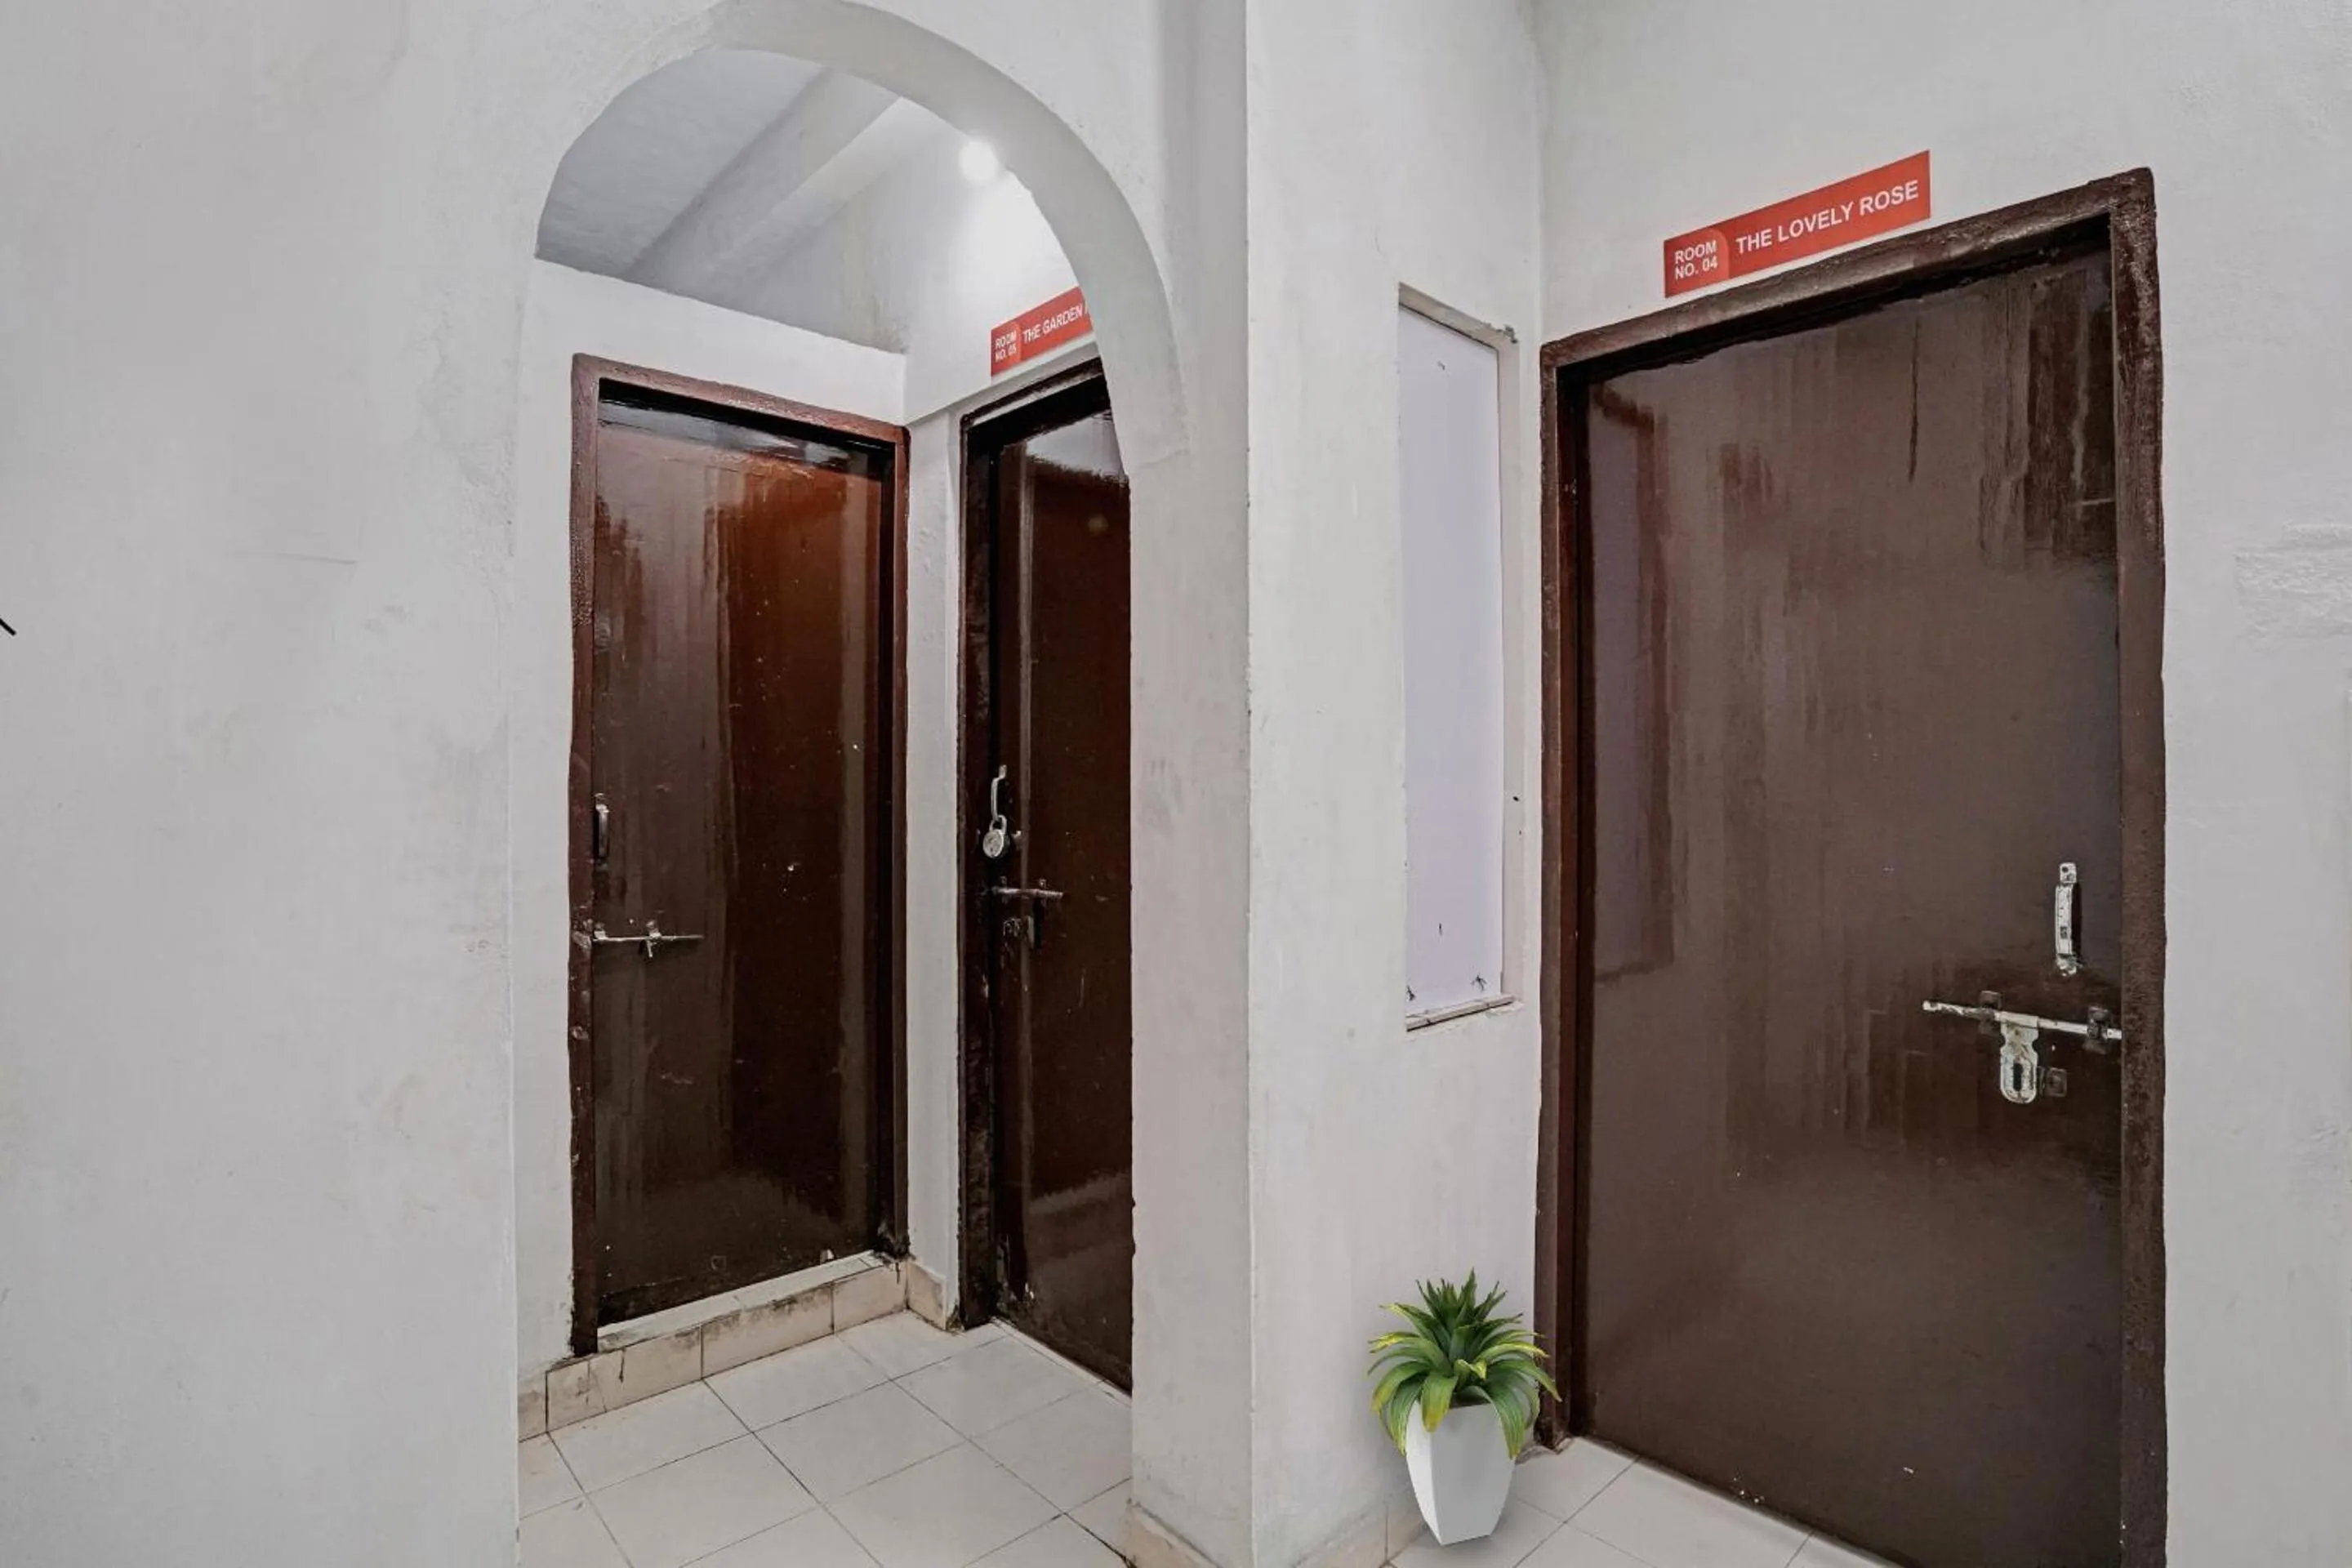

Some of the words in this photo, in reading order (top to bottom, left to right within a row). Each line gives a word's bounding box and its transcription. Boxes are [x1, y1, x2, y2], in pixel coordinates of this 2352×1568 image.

[1735, 229, 1772, 255] THE
[1777, 202, 1854, 243] LOVELY
[1859, 180, 1918, 216] ROSE
[1674, 240, 1717, 264] ROOM
[1674, 263, 1699, 281] NO.
[1703, 256, 1718, 271] 04
[1022, 323, 1041, 344] THE
[1043, 304, 1083, 335] GARDEN
[996, 330, 1017, 349] ROOM
